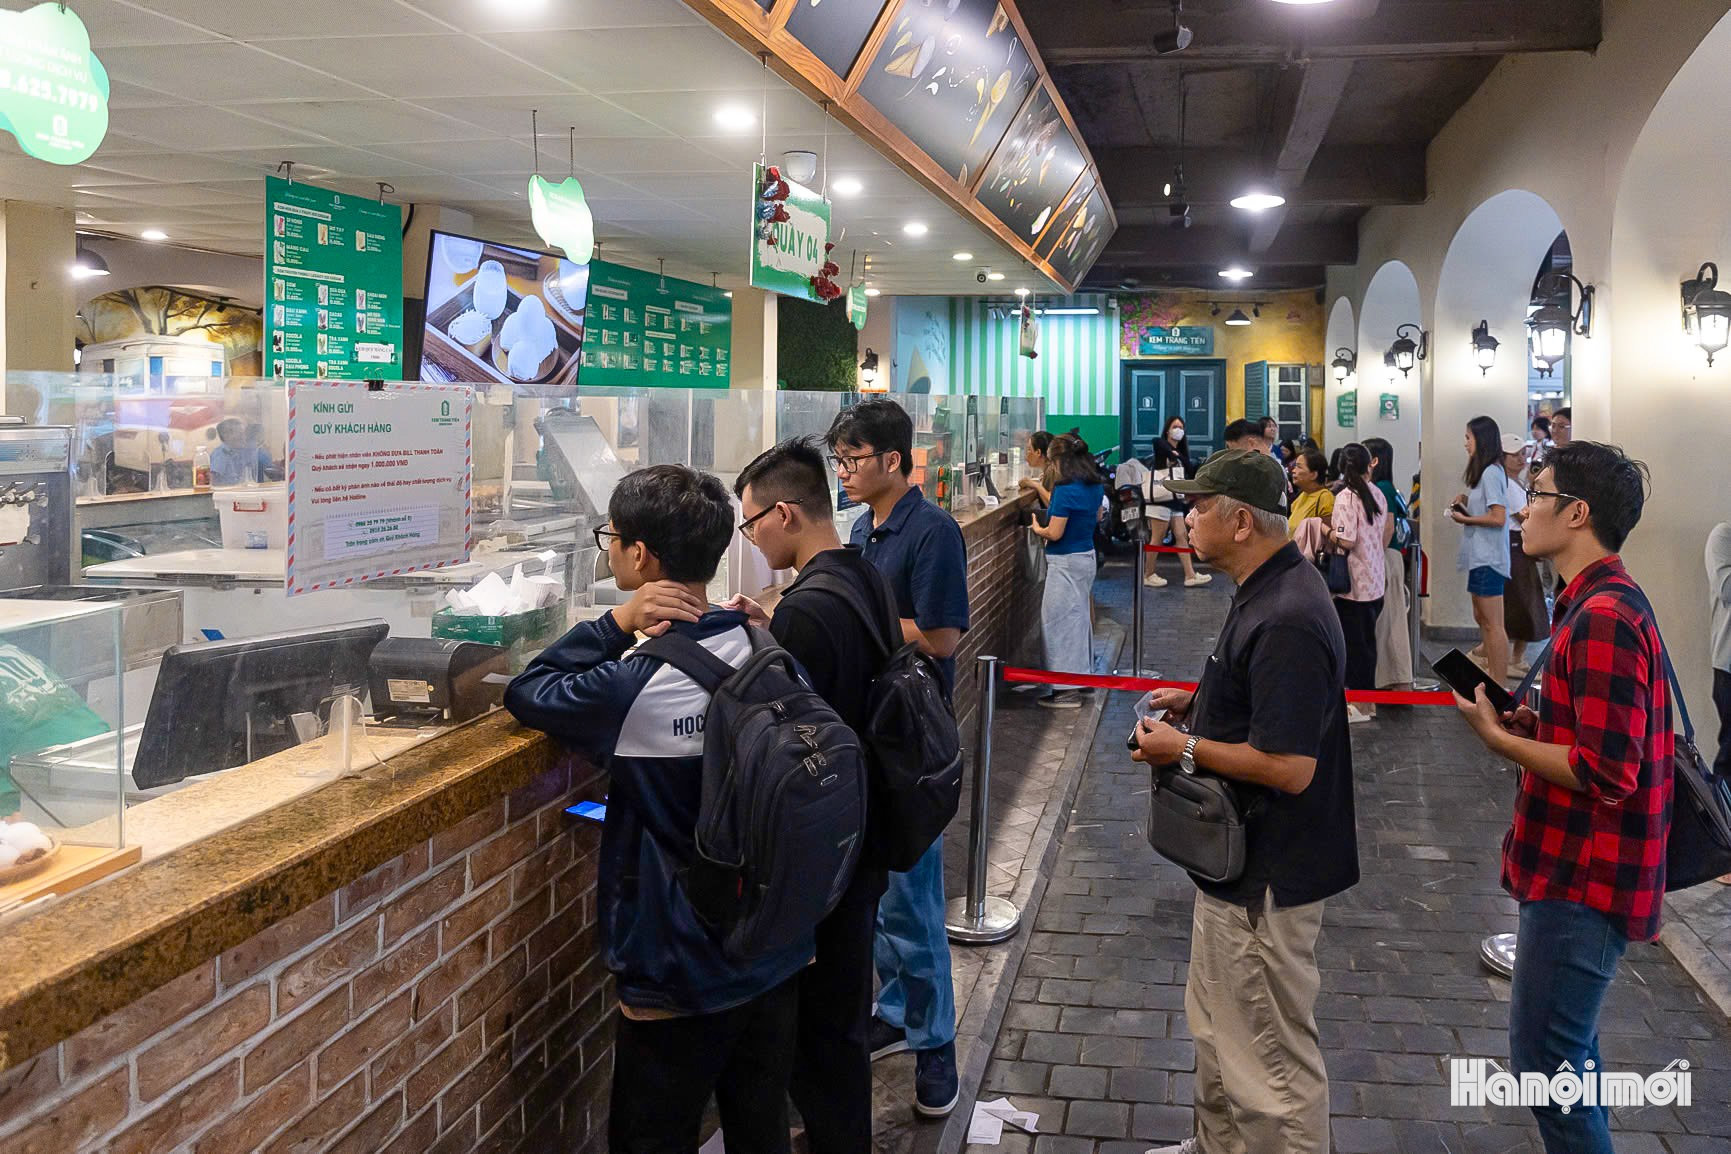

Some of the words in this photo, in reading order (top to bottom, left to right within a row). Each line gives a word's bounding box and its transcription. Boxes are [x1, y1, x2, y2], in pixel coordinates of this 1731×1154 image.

[806, 235, 818, 265] 04
[313, 401, 335, 413] KÍNH
[334, 421, 366, 434] KHÁCH
[367, 420, 392, 433] HÀNG
